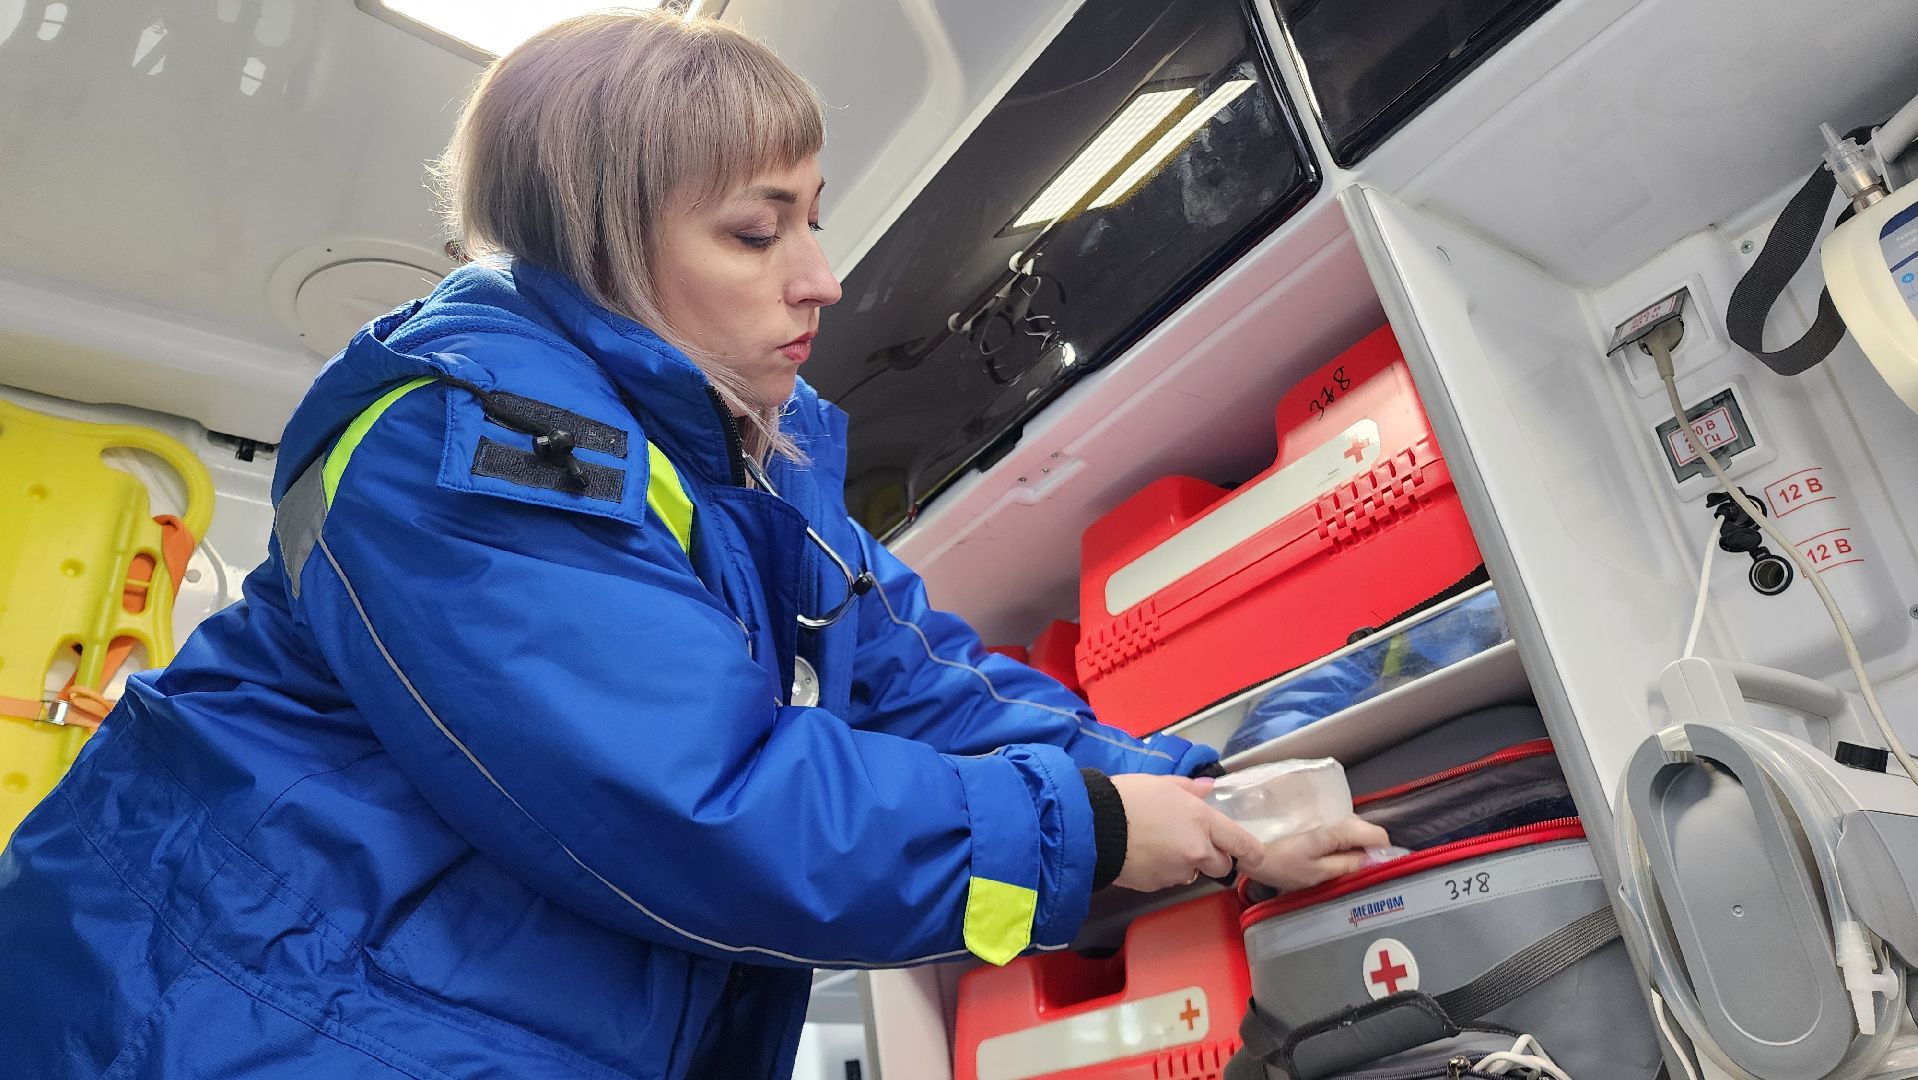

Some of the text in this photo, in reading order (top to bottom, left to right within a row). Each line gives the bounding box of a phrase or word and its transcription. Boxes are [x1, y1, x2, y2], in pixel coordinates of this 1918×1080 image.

[1705, 420, 1716, 431] В
[1704, 433, 1721, 445] Гц
[1779, 478, 1823, 503] 12 В
[1807, 538, 1852, 564] 12 В
[1445, 872, 1490, 900] 378
